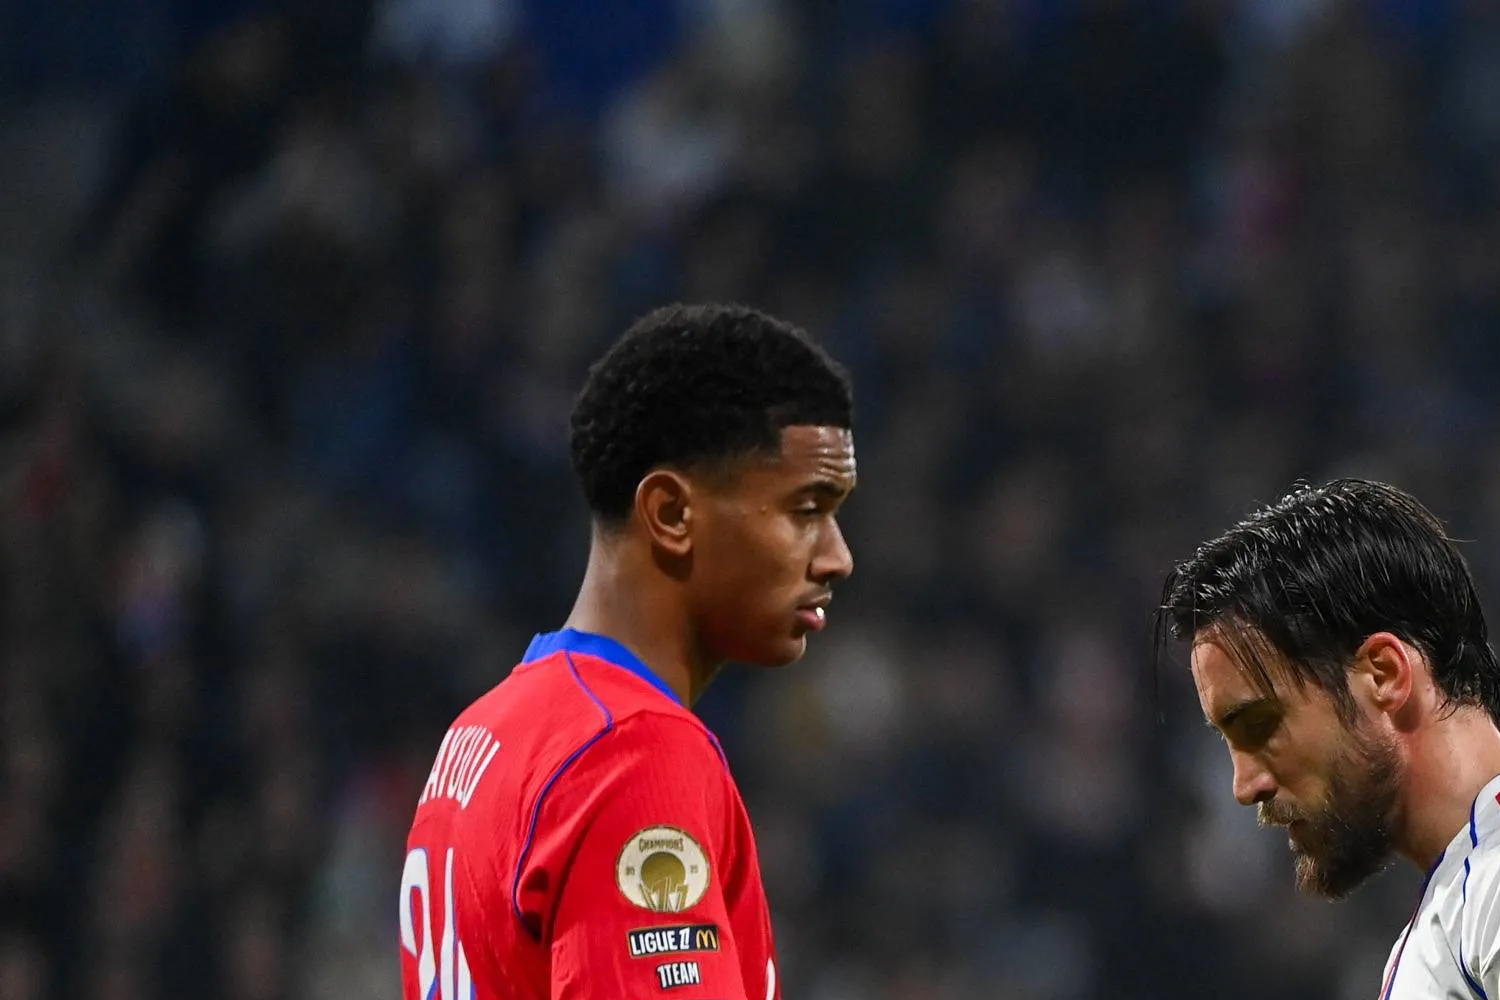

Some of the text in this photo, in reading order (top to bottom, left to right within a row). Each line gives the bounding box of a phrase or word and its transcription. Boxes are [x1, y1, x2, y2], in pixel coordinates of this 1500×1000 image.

[638, 837, 685, 853] CHAMPIONS
[630, 929, 678, 955] LIGUE
[656, 961, 700, 989] 1TEAM
